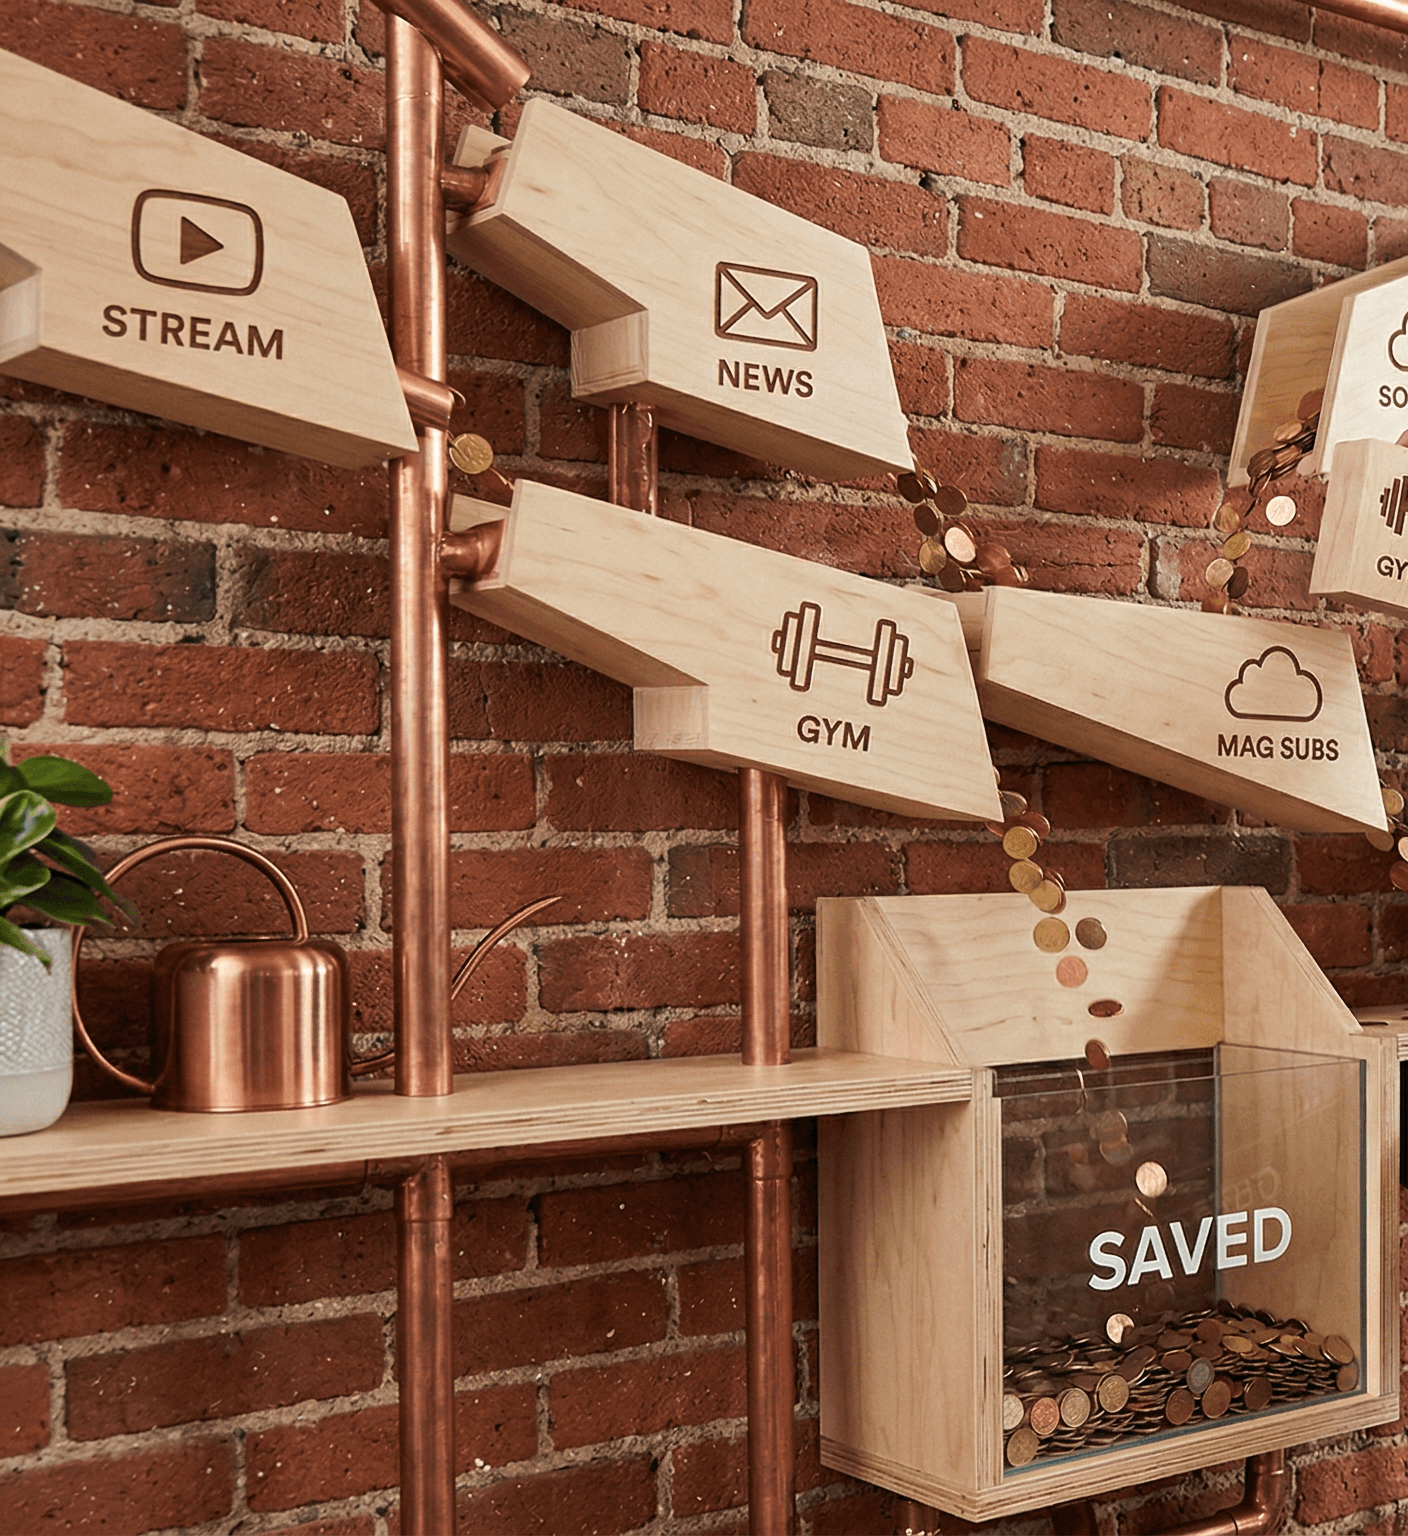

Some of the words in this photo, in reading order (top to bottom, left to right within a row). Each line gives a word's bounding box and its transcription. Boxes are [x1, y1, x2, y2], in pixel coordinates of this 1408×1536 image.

[101, 304, 285, 361] STREAM
[718, 358, 815, 398] NEWS
[796, 715, 872, 752] GYM
[1217, 733, 1275, 759] MAG
[1280, 736, 1339, 762] SUBS
[1088, 1206, 1292, 1291] SAVED
